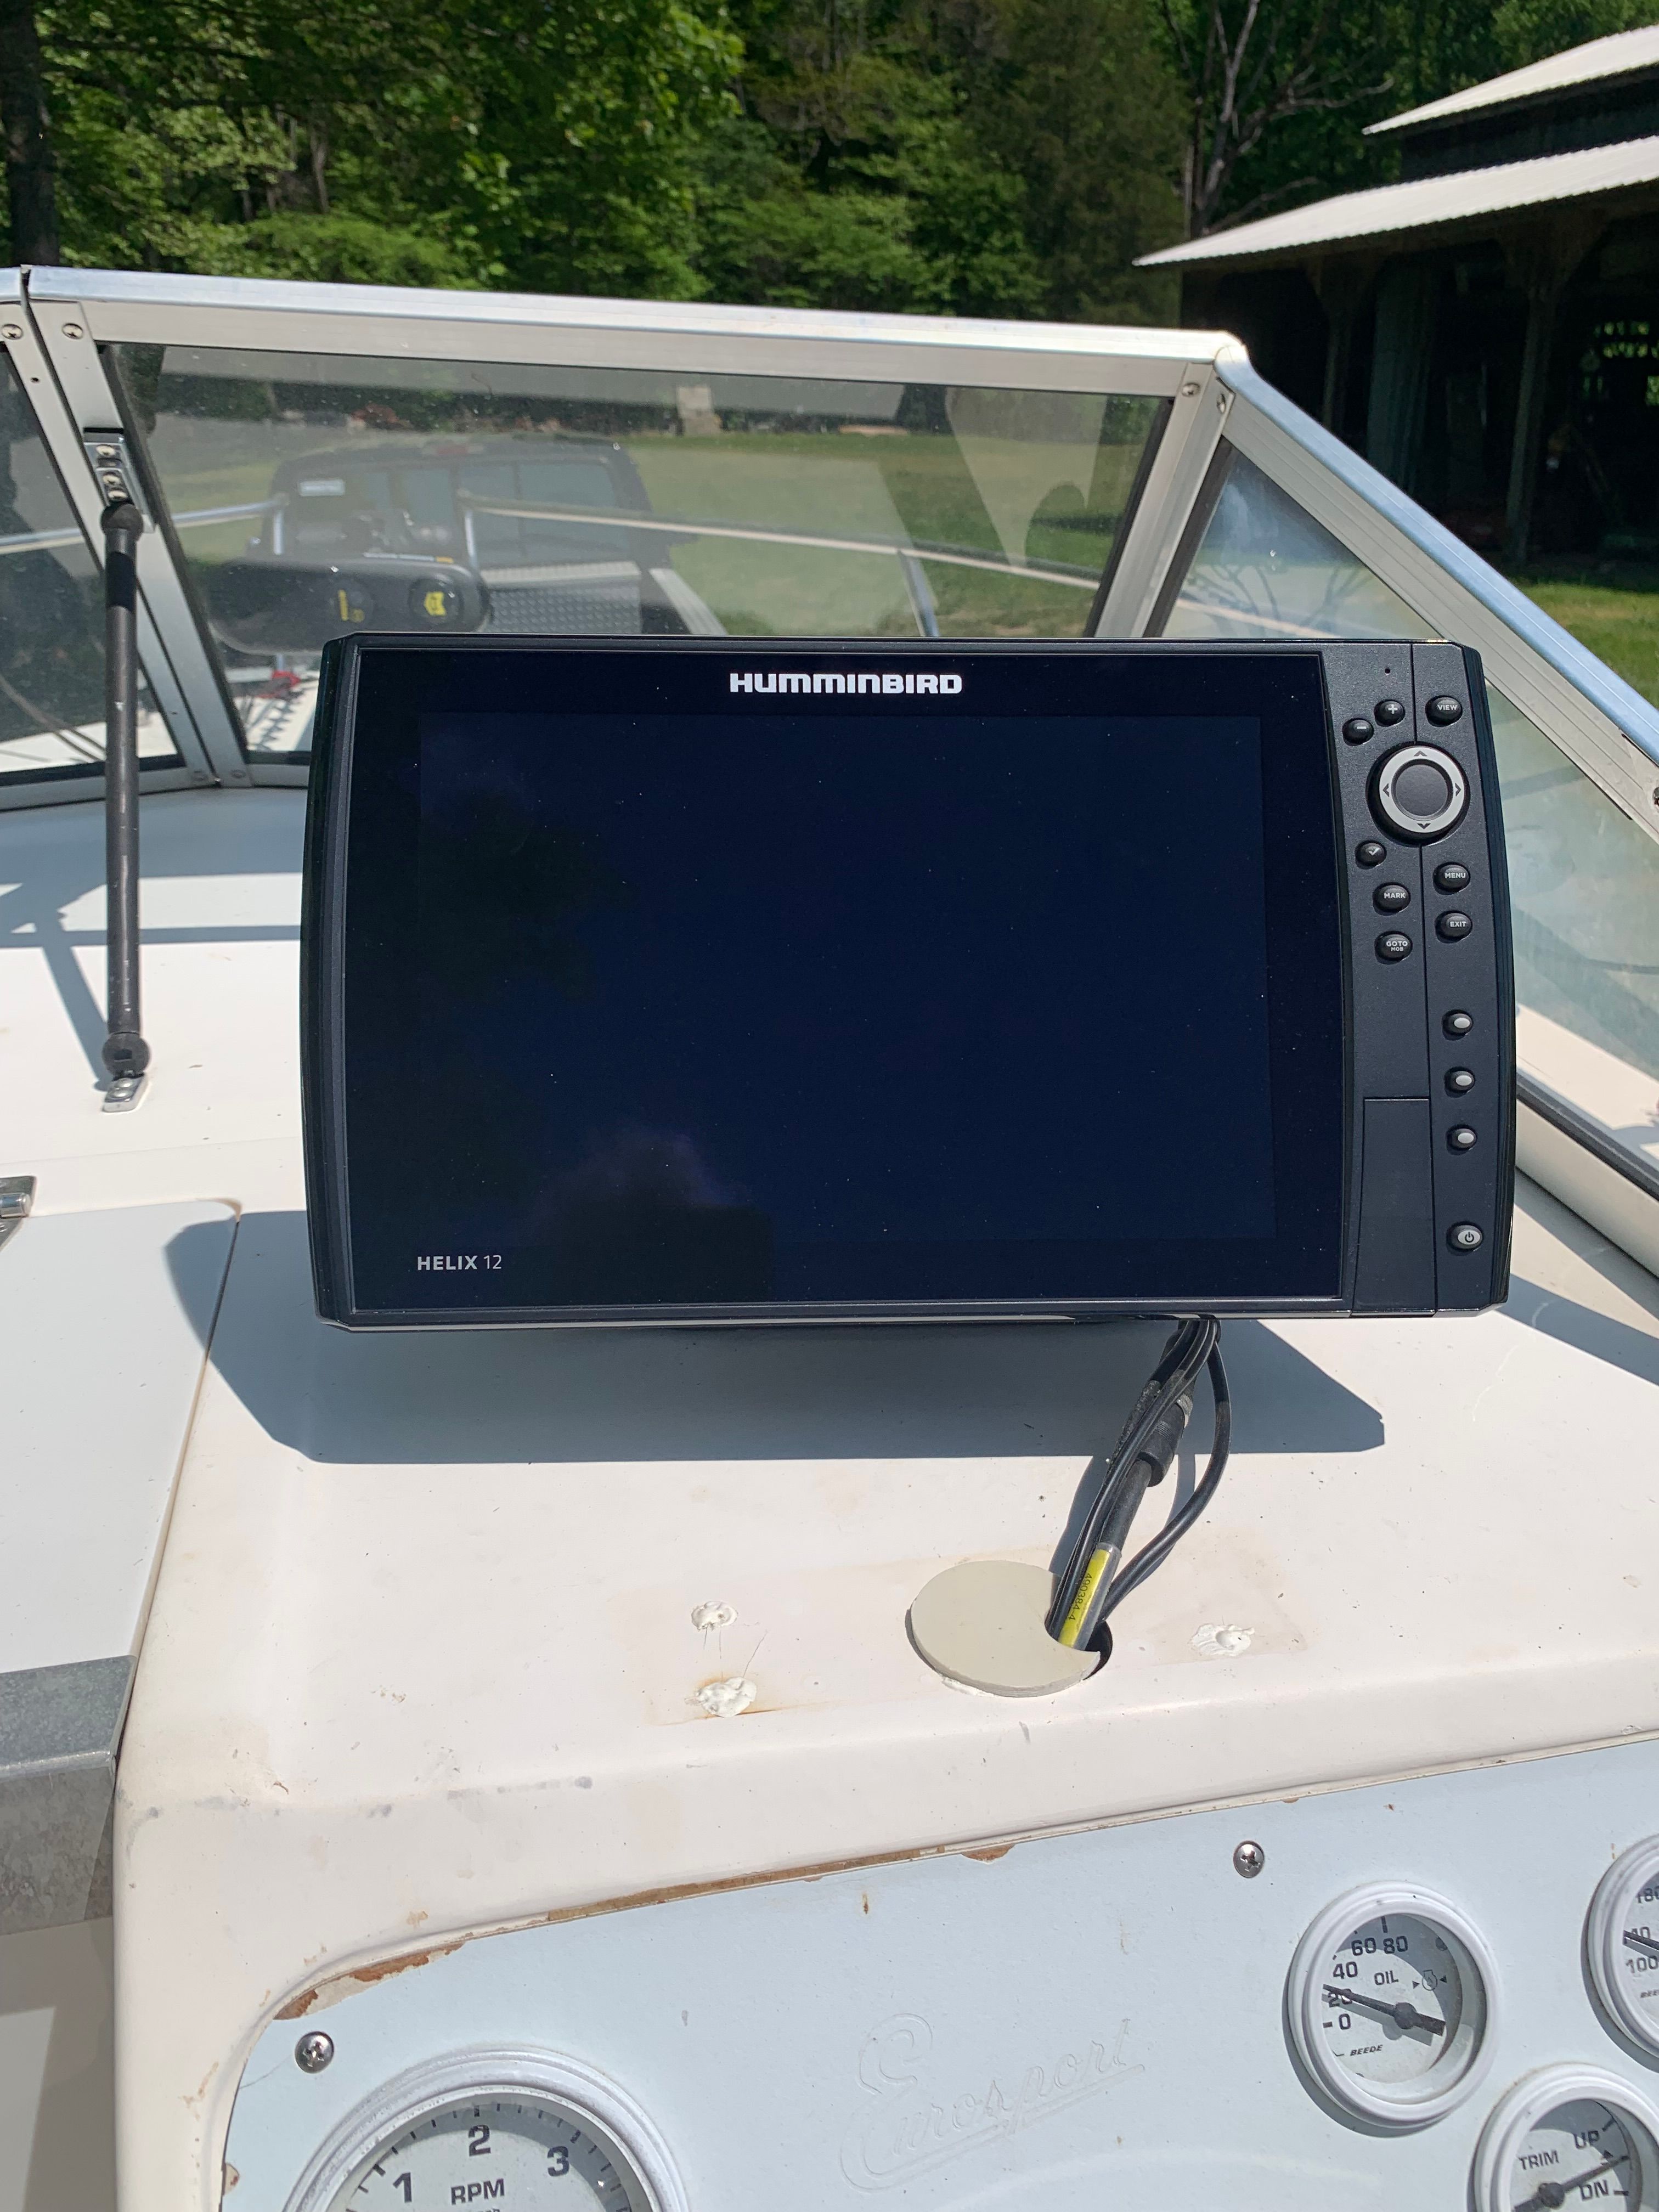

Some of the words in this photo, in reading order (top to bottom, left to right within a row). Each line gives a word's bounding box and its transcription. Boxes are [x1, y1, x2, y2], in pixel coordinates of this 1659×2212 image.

[730, 673, 962, 693] HUMMINBIRD
[417, 1255, 478, 1271] HELIX
[483, 1255, 502, 1269] 12
[1069, 1572, 1093, 1621] 490384-4
[1351, 1937, 1376, 1956] 60
[1383, 1936, 1408, 1954] 80
[1333, 1961, 1358, 1979] 40
[1626, 1955, 1658, 1974] 100
[1374, 1970, 1398, 1985] OIL
[1338, 2013, 1351, 2030] 0
[1350, 2044, 1383, 2056] BEEDE
[468, 2125, 492, 2157] 2
[1573, 2130, 1600, 2149] UP
[547, 2146, 570, 2177] 3
[1518, 2150, 1560, 2170] TRIM
[392, 2172, 413, 2203] 1
[450, 2178, 505, 2205] RPM
[1578, 2180, 1609, 2202] DN
